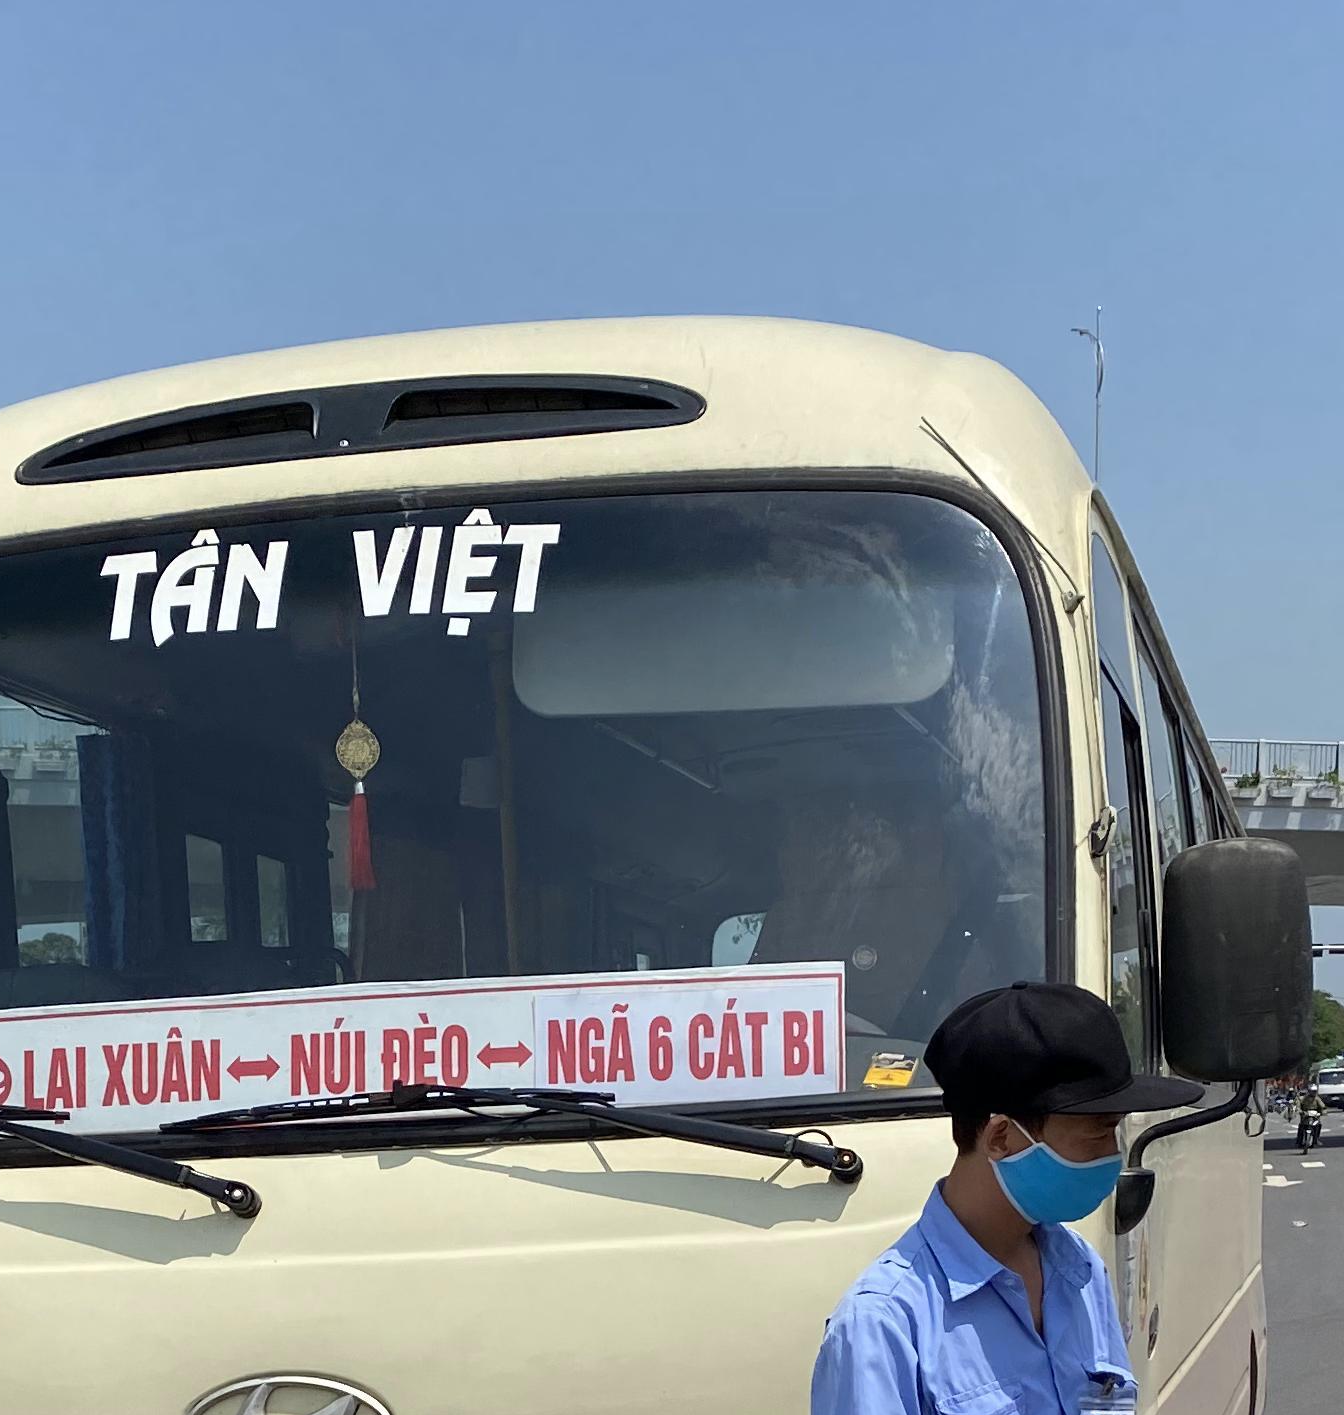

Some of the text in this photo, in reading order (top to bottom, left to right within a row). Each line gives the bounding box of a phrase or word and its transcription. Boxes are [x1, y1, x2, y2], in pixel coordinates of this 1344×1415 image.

[99, 507, 561, 647] TÂN VIỆT
[101, 1026, 222, 1107] XUÂN
[290, 1017, 367, 1097] NÚI
[380, 1012, 469, 1092] ĐÈO
[547, 1003, 636, 1085] NGÃ
[648, 1016, 674, 1082] 6
[688, 997, 769, 1081] CÁT
[782, 1009, 825, 1077] BI
